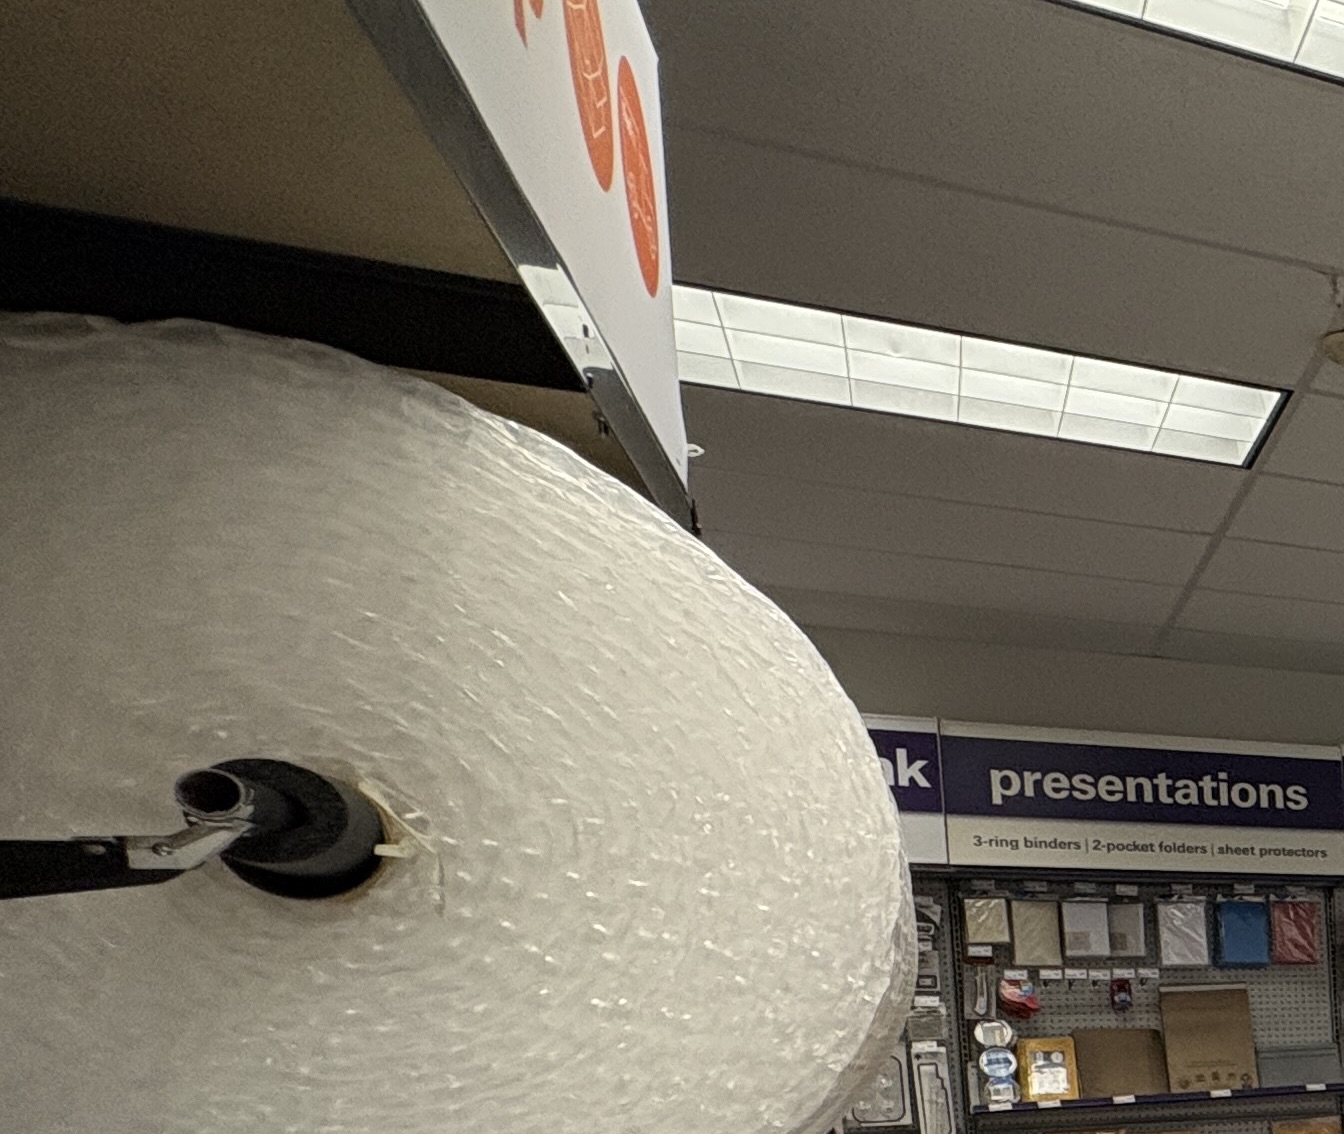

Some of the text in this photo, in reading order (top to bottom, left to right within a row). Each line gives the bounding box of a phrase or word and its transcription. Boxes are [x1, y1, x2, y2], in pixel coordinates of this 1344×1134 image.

[879, 747, 933, 789] nk
[989, 767, 1309, 812] presentations
[972, 836, 1329, 861] 3-ring binders 2-pocket folders sheet protectors
